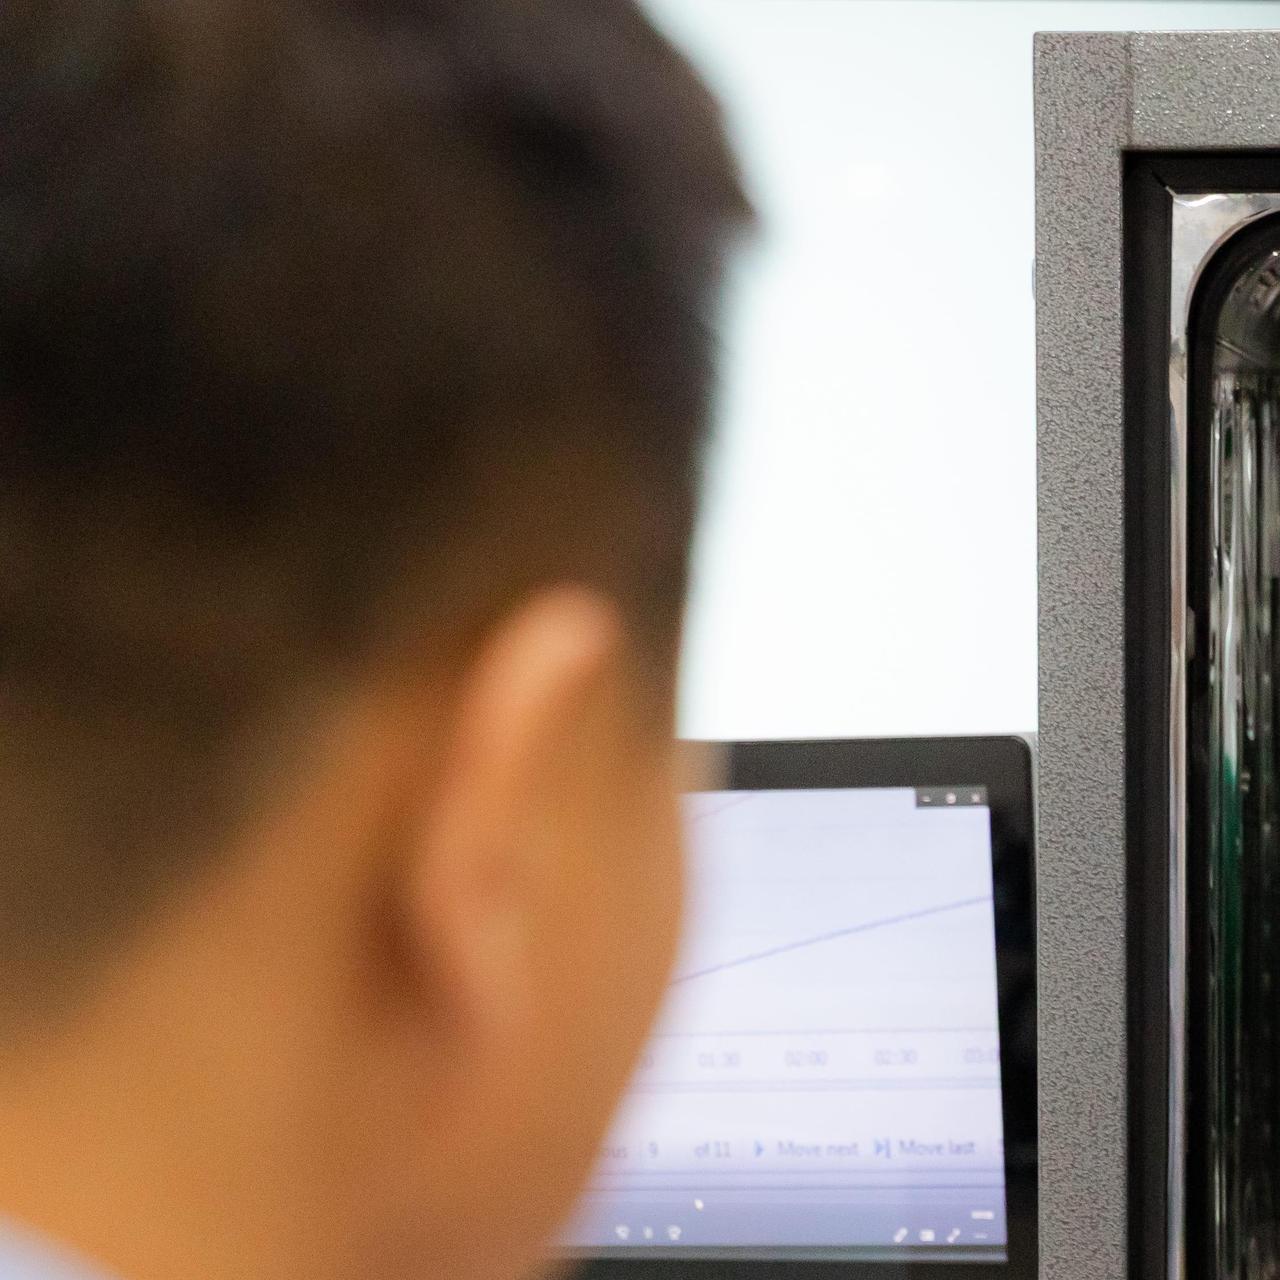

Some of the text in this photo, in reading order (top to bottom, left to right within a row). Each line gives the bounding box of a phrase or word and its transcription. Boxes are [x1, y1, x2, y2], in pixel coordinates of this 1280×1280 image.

[698, 1051, 741, 1067] 01:30
[784, 1050, 828, 1066] 02:00
[873, 1049, 918, 1065] 02:30
[693, 1140, 711, 1158] of
[714, 1141, 731, 1158] 11
[777, 1140, 824, 1157] Move
[827, 1142, 859, 1157] next
[898, 1139, 945, 1156] Move
[948, 1138, 975, 1155] last
